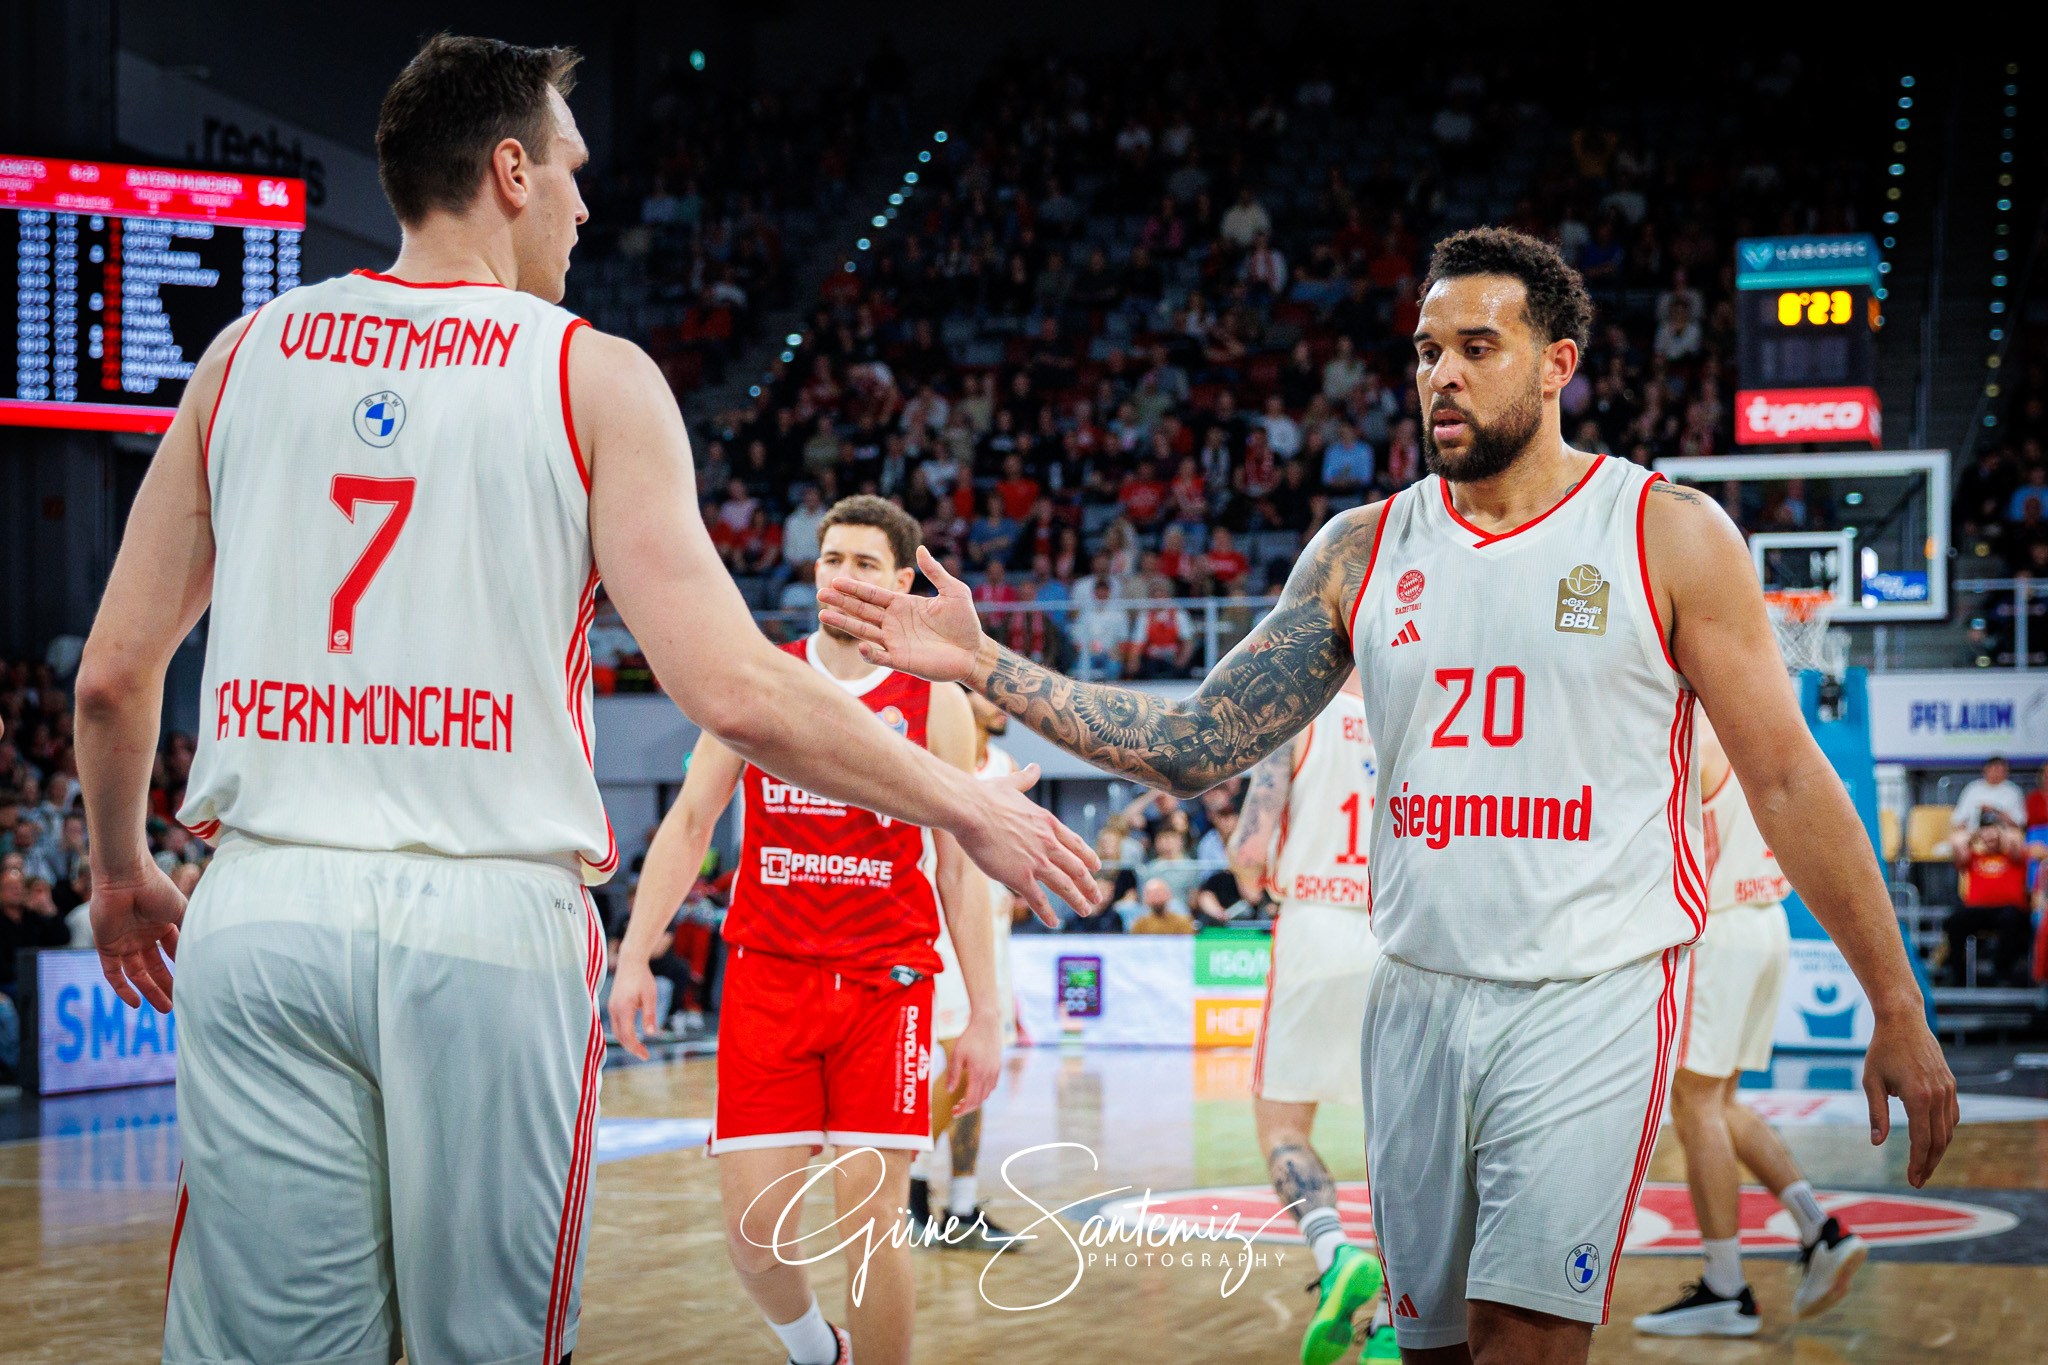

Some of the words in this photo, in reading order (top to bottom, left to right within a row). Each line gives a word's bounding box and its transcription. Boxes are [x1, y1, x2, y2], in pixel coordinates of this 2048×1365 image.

[280, 312, 519, 371] VOIGTMANN
[364, 393, 401, 407] BMW
[1745, 396, 1864, 437] tipico
[328, 473, 417, 654] 7
[1559, 612, 1600, 630] BBL
[215, 679, 335, 743] AYERN
[342, 684, 513, 753] MÜNCHEN
[1431, 665, 1526, 749] 20
[1390, 782, 1593, 850] siegmund
[791, 853, 893, 880] PRIOSAFE
[902, 1005, 919, 1114] DATOLUTION
